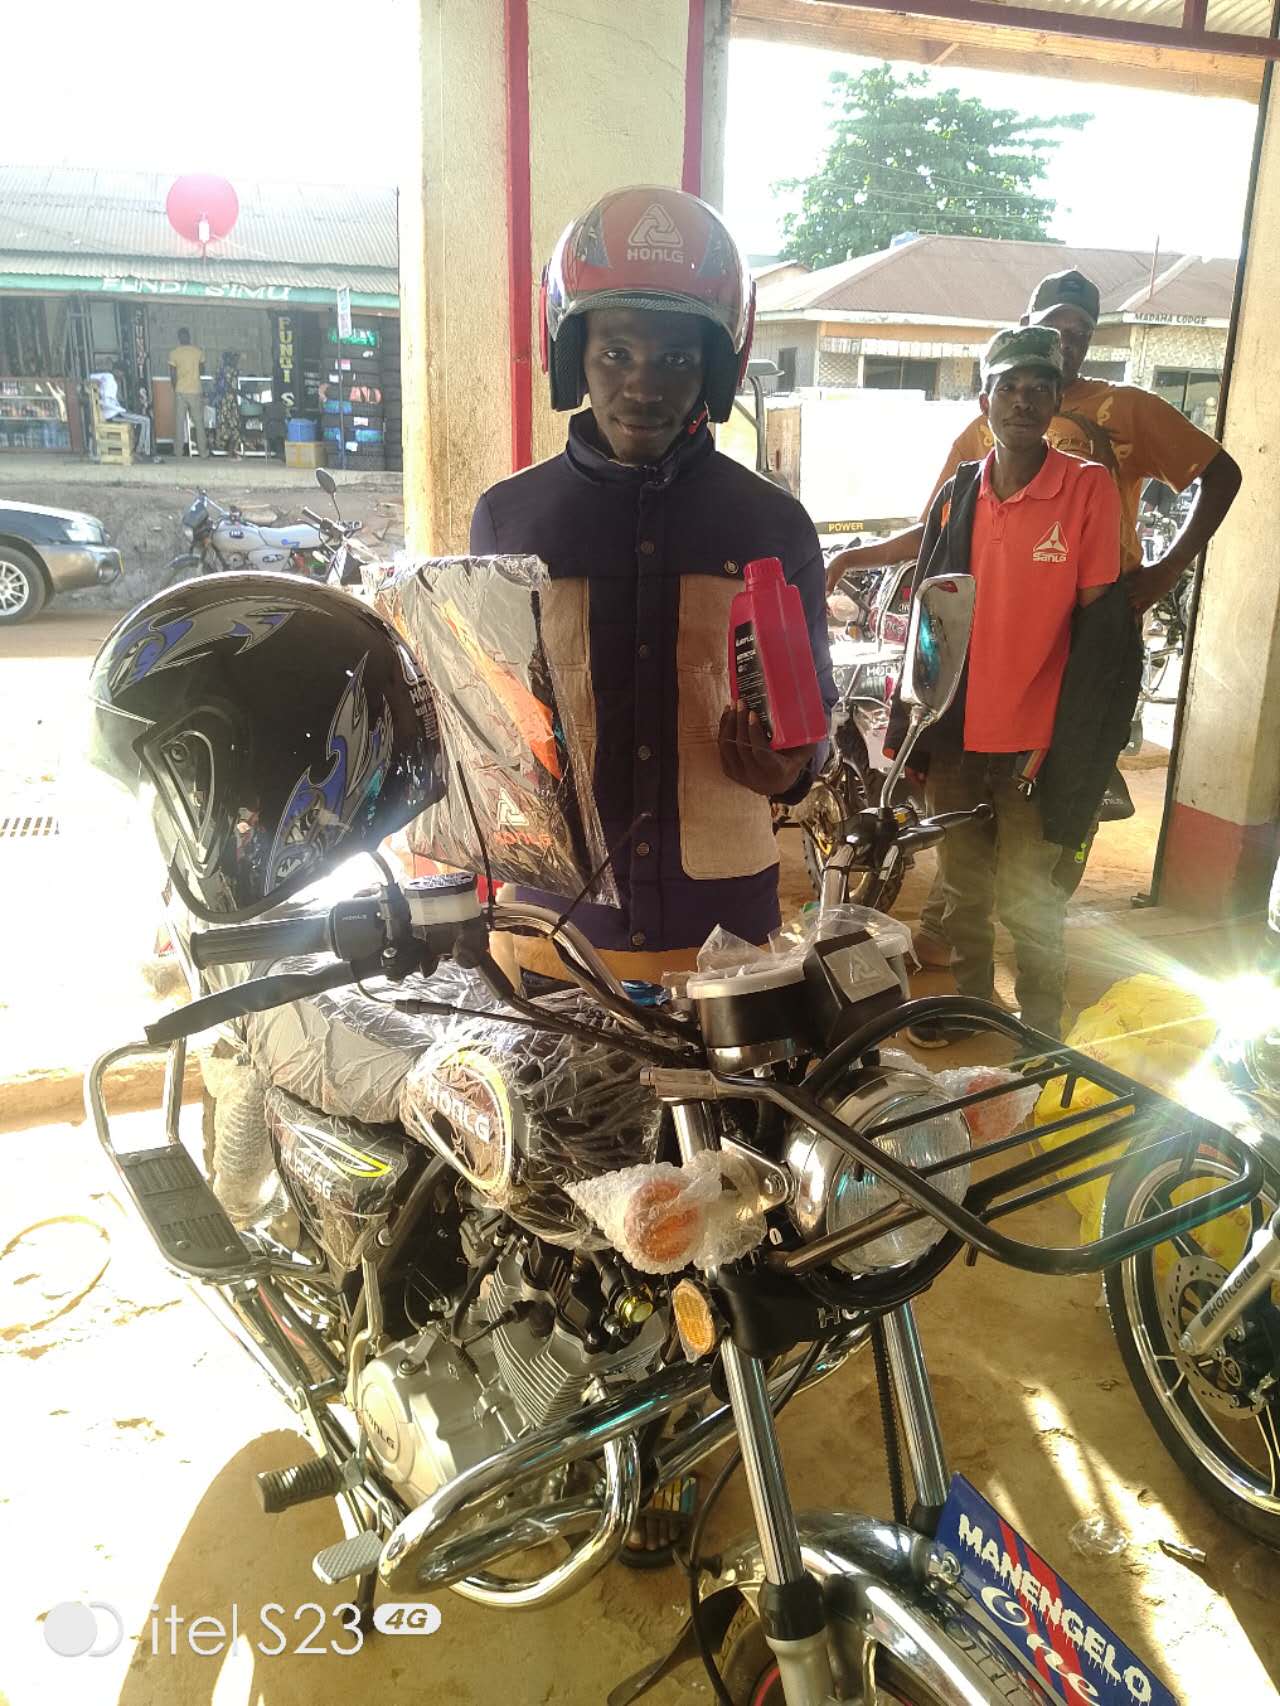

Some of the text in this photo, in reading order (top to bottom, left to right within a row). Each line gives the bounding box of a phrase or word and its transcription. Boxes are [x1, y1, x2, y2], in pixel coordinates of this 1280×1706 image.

[279, 317, 293, 383] FUNDI
[828, 522, 864, 532] POWER
[958, 1513, 1152, 1706] MANENGELO
